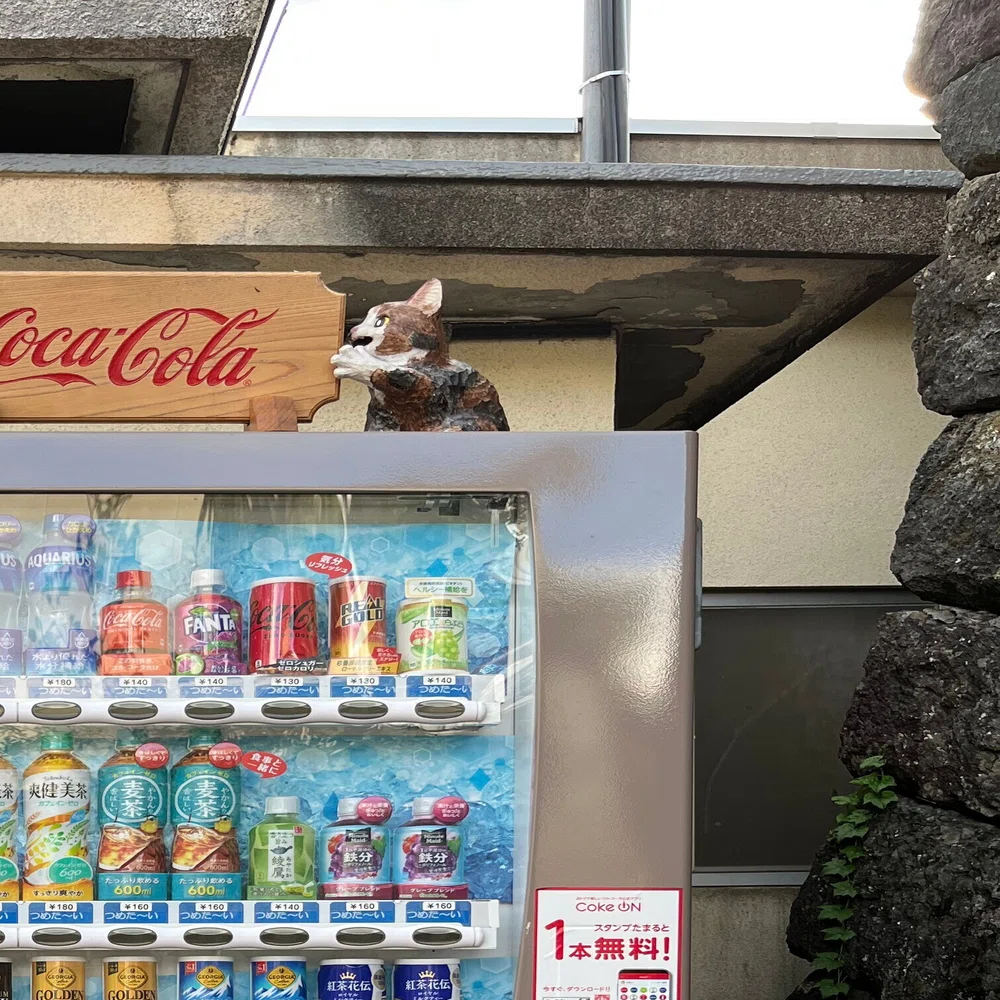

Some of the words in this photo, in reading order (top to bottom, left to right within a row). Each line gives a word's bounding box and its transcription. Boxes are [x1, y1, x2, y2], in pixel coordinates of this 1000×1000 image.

[28, 551, 91, 568] AQUARIUS
[320, 555, 343, 564] 気分
[308, 561, 348, 573] リフレッシュ
[412, 586, 468, 594] ヘルシー補給を
[341, 595, 384, 616] REAL
[103, 607, 164, 630] Coca-Cola
[184, 612, 236, 635] FANTA
[341, 609, 384, 628] GOLD
[251, 753, 282, 767] 食事と
[247, 761, 279, 775] 一緒に
[29, 781, 87, 799] 爽健美茶
[121, 780, 147, 818] 麦茶
[194, 780, 219, 818] 麦茶
[343, 851, 374, 863] 鉄分
[418, 852, 449, 863] 鉄分
[58, 869, 81, 877] 600
[33, 890, 83, 898] すっきり爽やか
[114, 885, 152, 895] 600ml
[188, 885, 226, 895] 600ml
[575, 902, 615, 912] Coke
[618, 901, 641, 912] ON
[594, 924, 669, 932] スタンプたまると
[545, 919, 670, 961] 1本無料!
[327, 980, 371, 991] 紅茶花伝
[405, 980, 450, 990] 紅茶花伝
